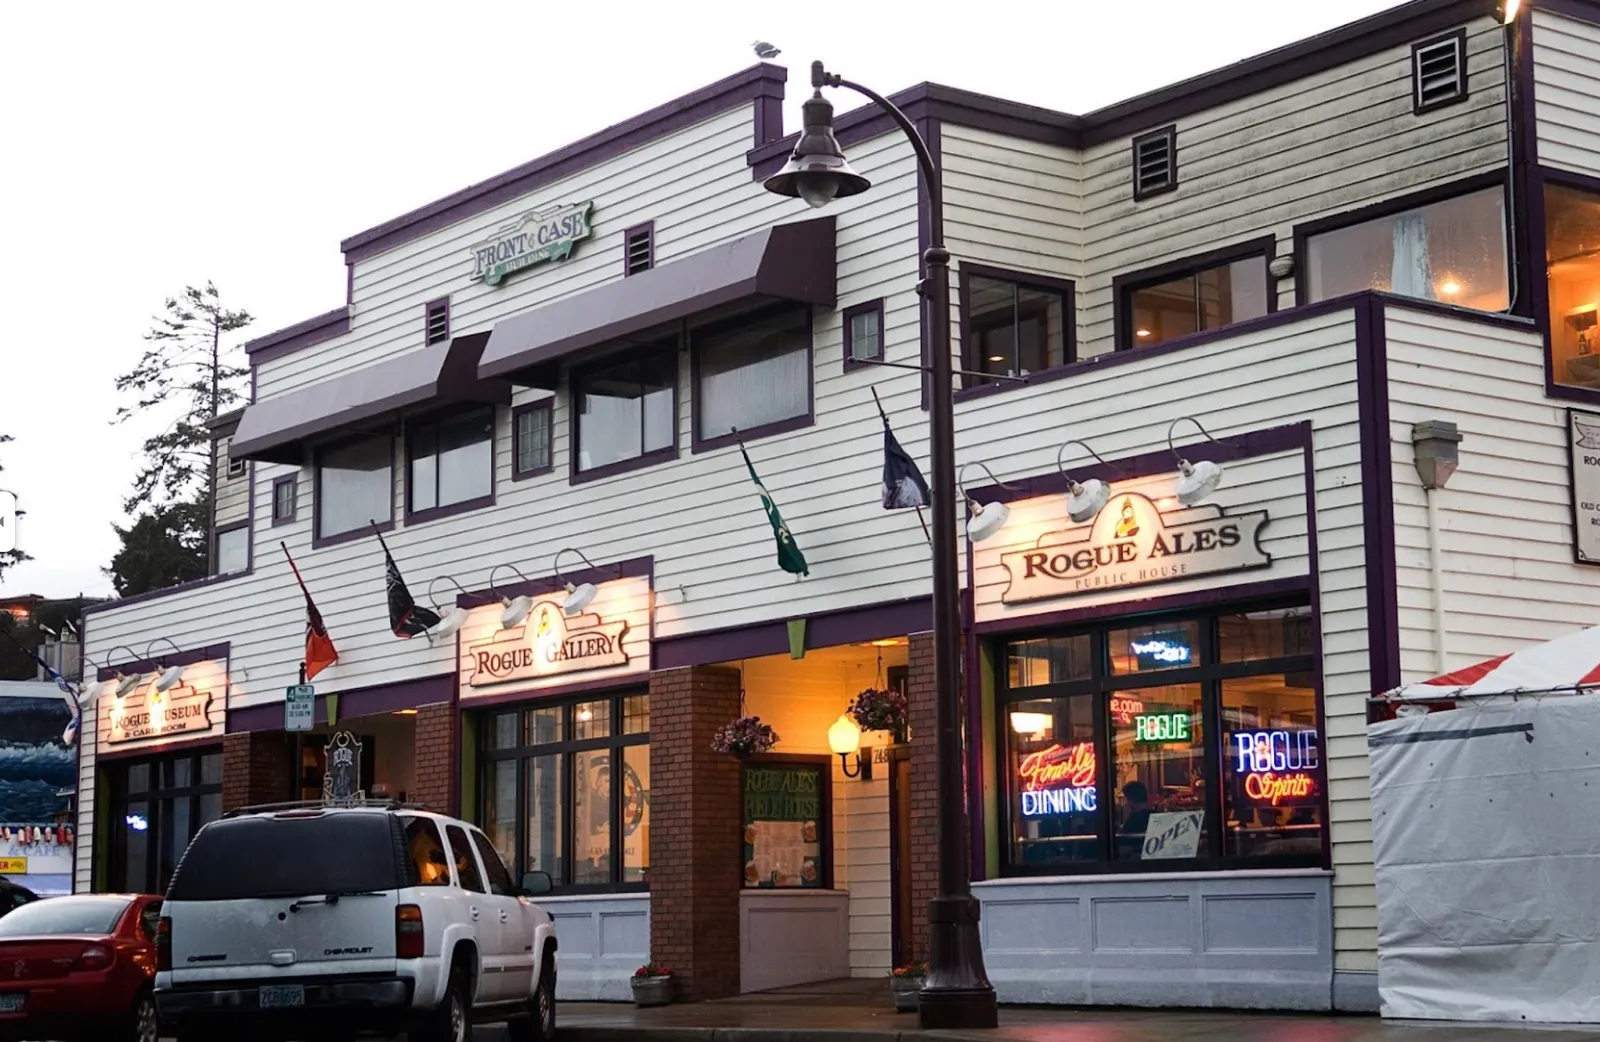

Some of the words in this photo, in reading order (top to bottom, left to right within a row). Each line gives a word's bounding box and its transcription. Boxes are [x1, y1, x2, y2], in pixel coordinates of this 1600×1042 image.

[475, 233, 528, 275] FRONT
[537, 211, 583, 245] CASE
[505, 247, 551, 272] BUILDING
[1023, 542, 1139, 580] ROGUE
[1147, 523, 1241, 560] ALES
[1075, 572, 1127, 590] PUBLIC
[1139, 564, 1188, 580] HOUSE
[477, 648, 533, 677] ROGUE
[545, 632, 616, 663] GALLERY
[160, 704, 202, 722] USEUM
[161, 723, 187, 733] ROOM
[1135, 714, 1188, 741] ROGUE
[1019, 742, 1096, 791] Family
[1234, 729, 1319, 773] ROGUE
[1022, 786, 1097, 815] DINING
[1245, 771, 1311, 806] Spirits
[1145, 813, 1203, 856] OPEN
